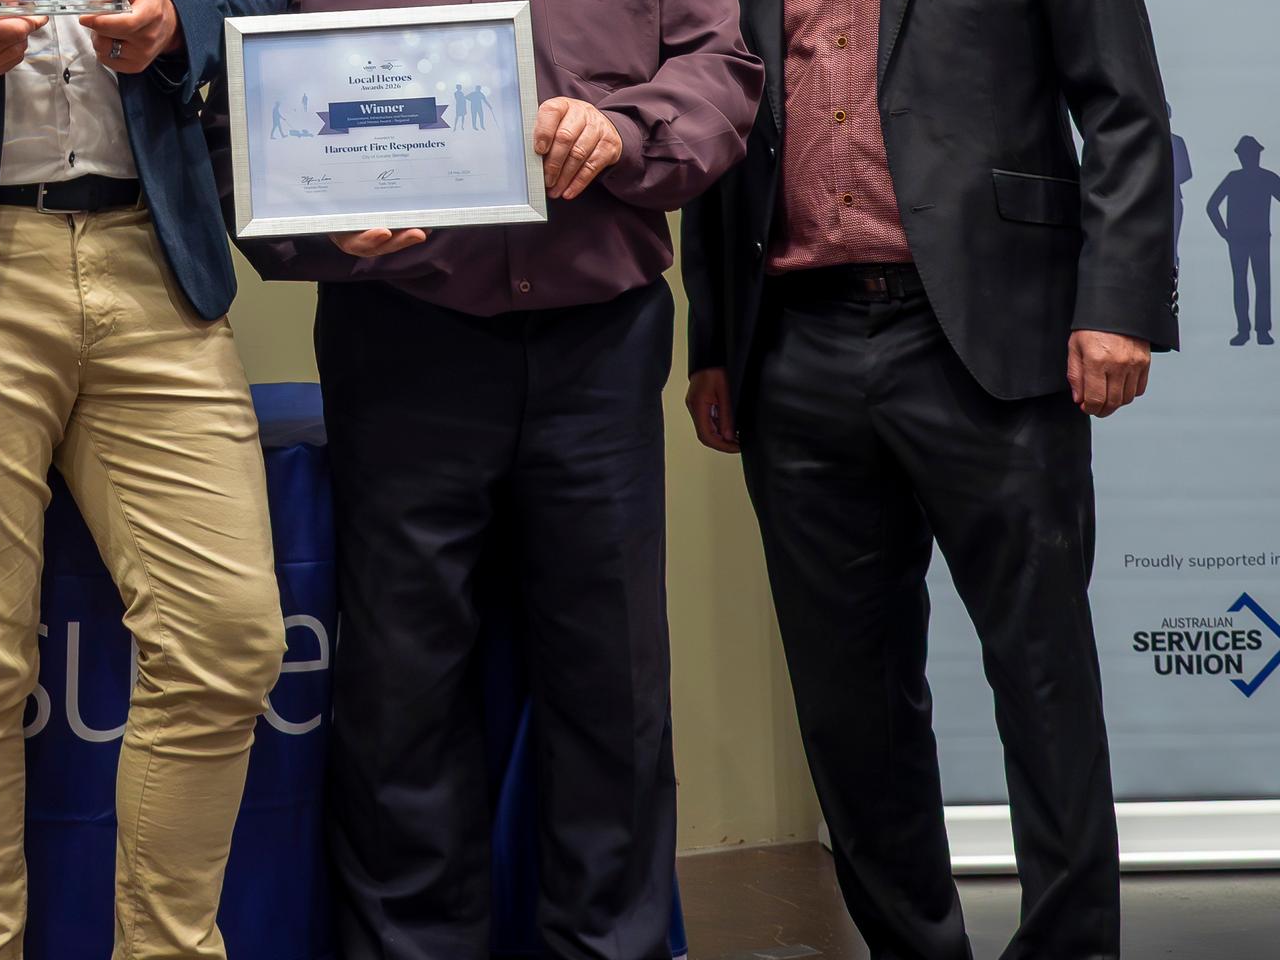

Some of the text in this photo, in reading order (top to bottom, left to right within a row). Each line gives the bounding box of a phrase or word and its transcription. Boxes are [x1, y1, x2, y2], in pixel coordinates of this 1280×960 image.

[348, 74, 412, 84] Local Heroes
[360, 104, 404, 114] Winner
[325, 140, 446, 154] Harcourt Fire Responders
[1124, 554, 1184, 570] Proudly
[1188, 552, 1266, 569] supported
[1161, 617, 1233, 628] AUSTRALIAN
[1132, 630, 1262, 652] SERVICES
[1154, 654, 1243, 675] UNION
